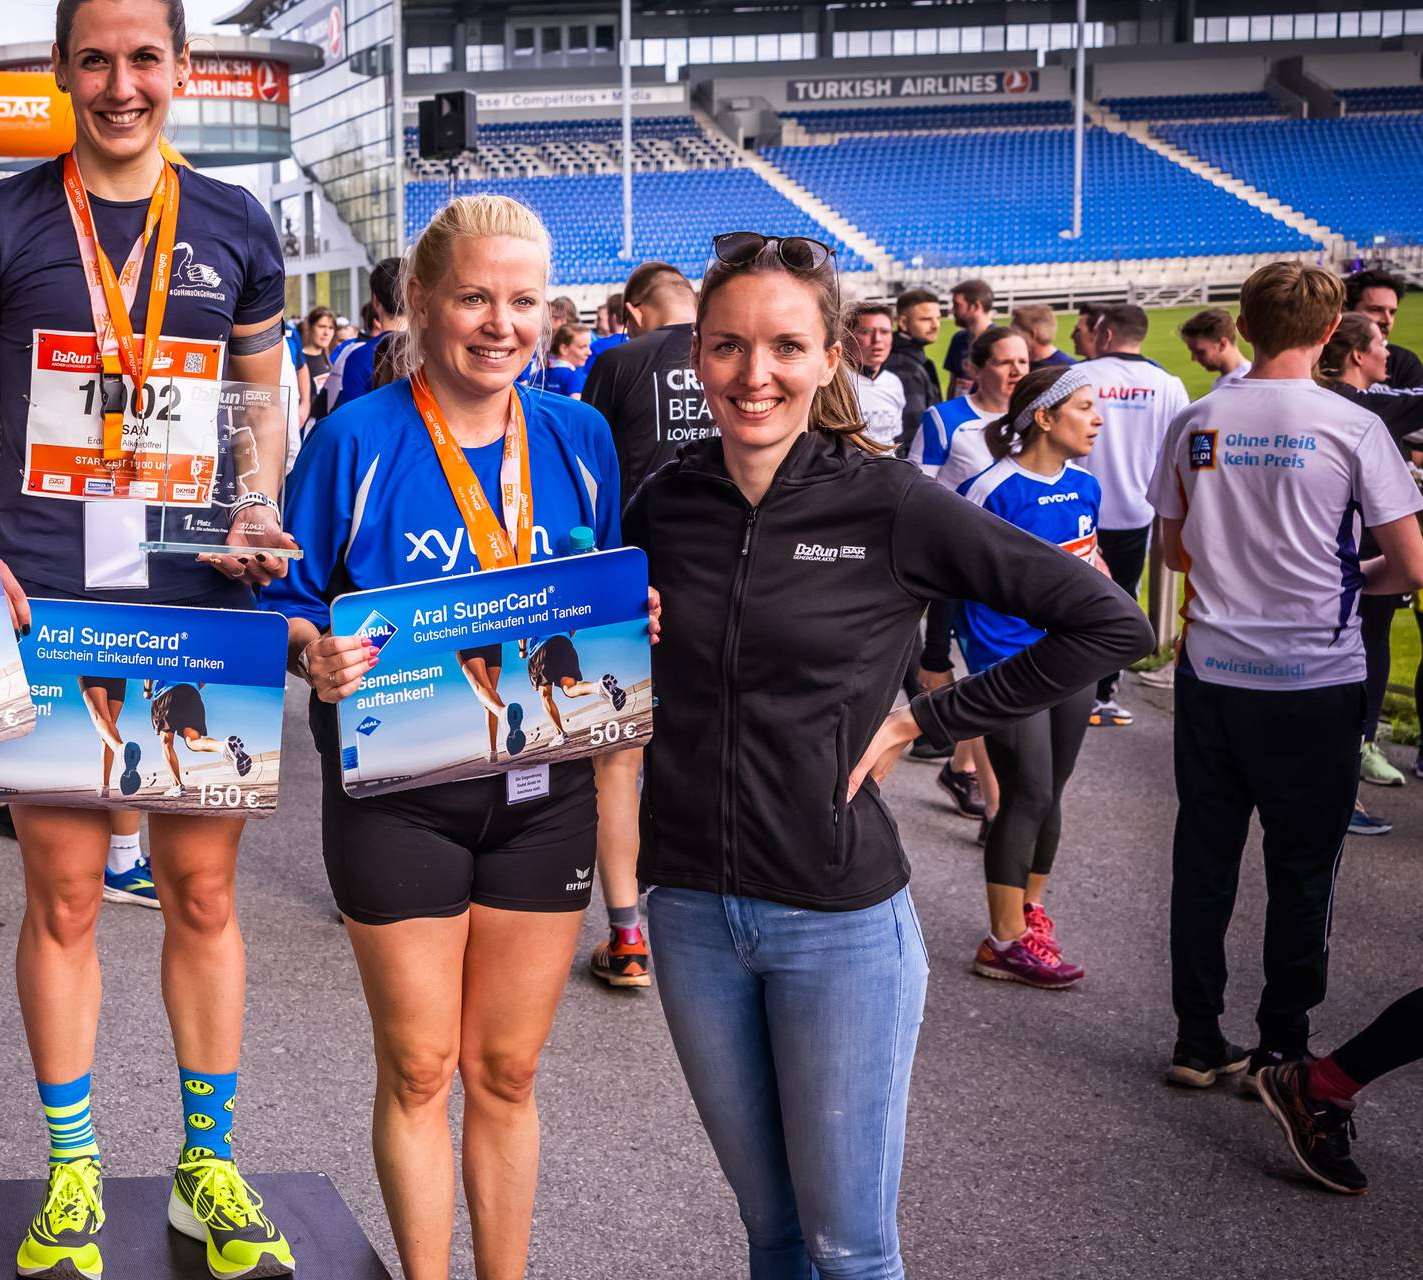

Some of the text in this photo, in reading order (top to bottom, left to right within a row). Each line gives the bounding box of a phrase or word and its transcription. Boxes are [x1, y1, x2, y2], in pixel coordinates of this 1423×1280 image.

[184, 80, 254, 97] AIRLINES
[795, 75, 998, 100] TURKISH AIRLINES
[512, 91, 595, 107] Competitors
[611, 89, 651, 102] Mdia
[51, 350, 93, 365] B2Run
[79, 378, 182, 422] 102
[122, 424, 149, 437] SAN
[1224, 433, 1317, 450] Ohne Fleiß
[1224, 451, 1306, 469] kein Preis
[403, 525, 554, 573] xym
[794, 543, 839, 558] B2Run
[412, 608, 448, 628] Aral
[413, 603, 592, 643] Gutschein Einkaufen und Tanken
[37, 625, 75, 645] Aral
[359, 625, 392, 639] ARAL
[37, 647, 225, 670] Gutschein Einkaufen und Tanken
[358, 664, 444, 691] Gemeinsam
[356, 683, 435, 710] auftanken!
[359, 720, 379, 731] ARAL
